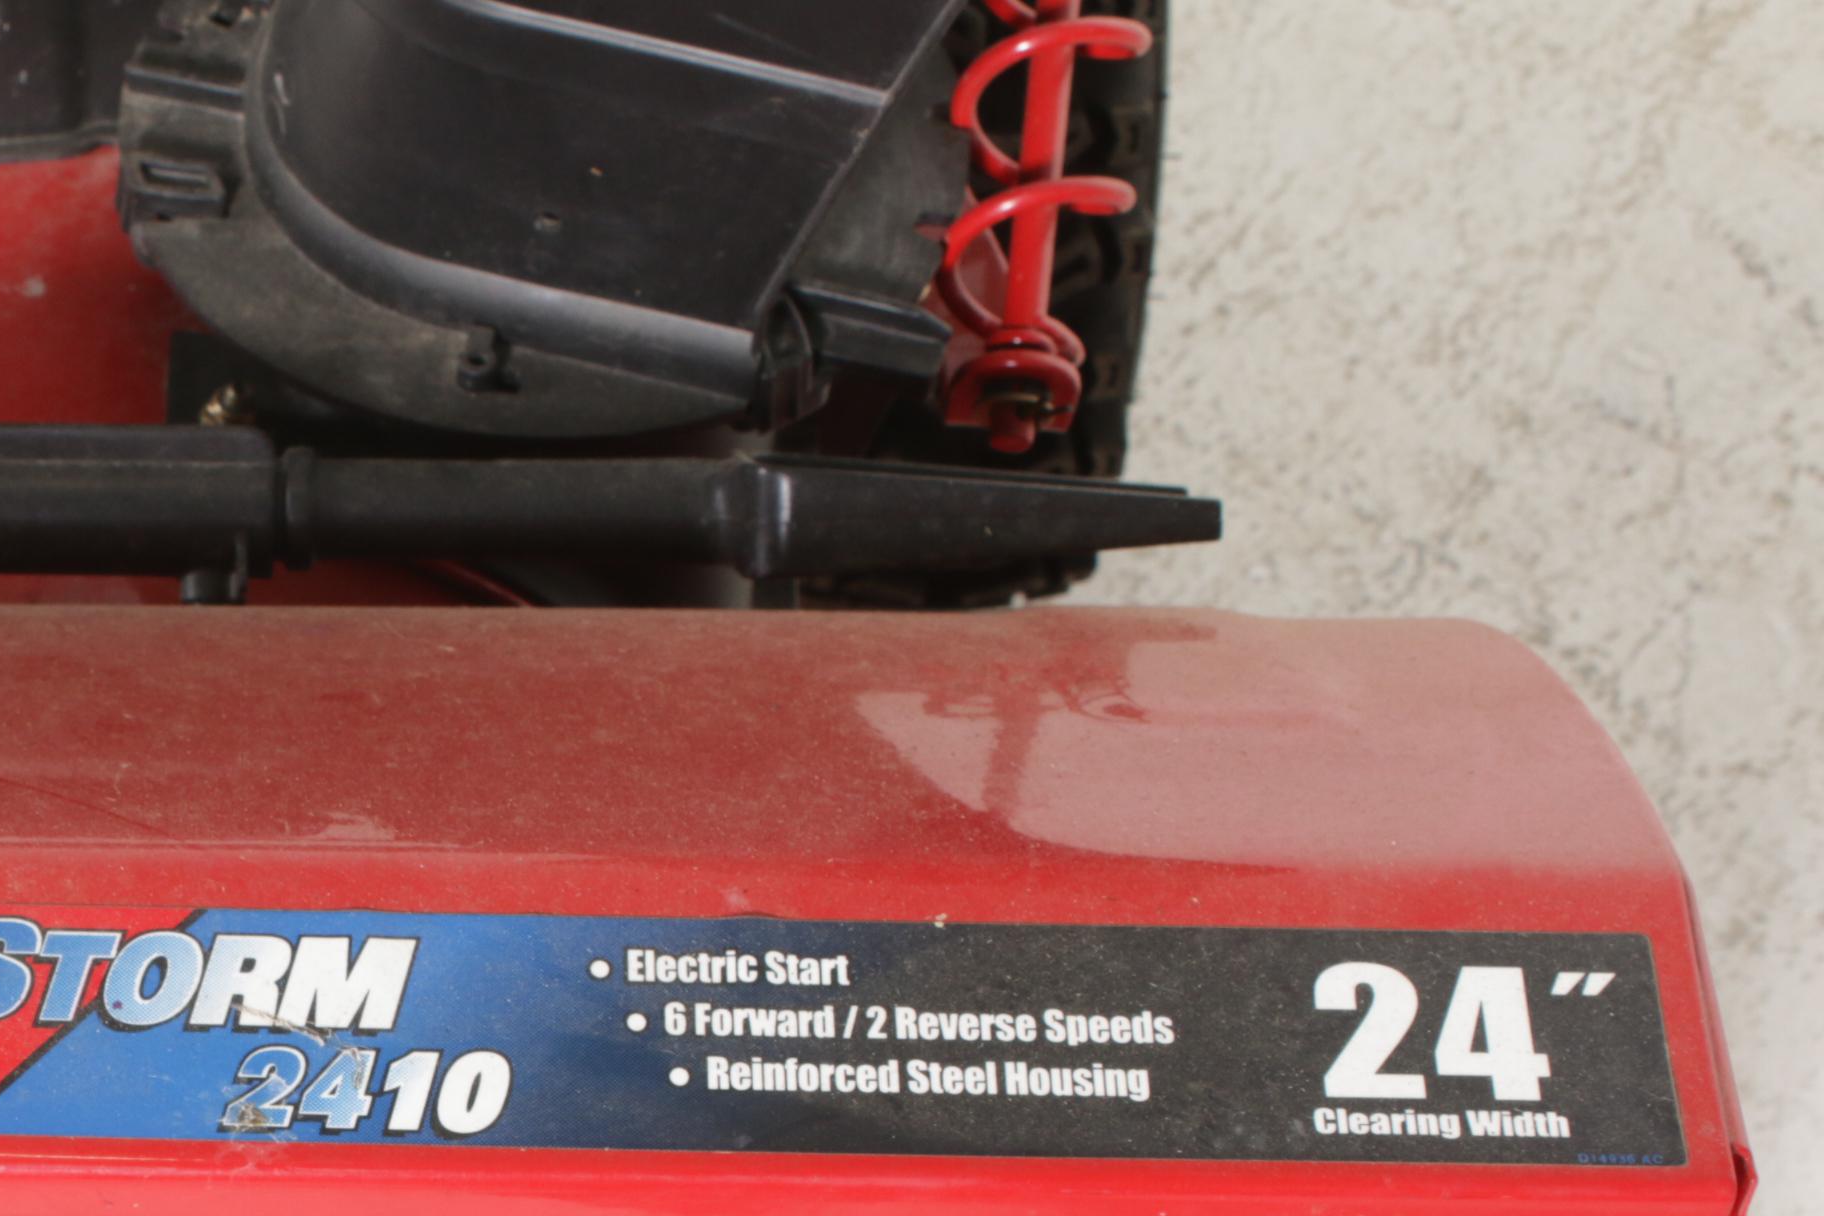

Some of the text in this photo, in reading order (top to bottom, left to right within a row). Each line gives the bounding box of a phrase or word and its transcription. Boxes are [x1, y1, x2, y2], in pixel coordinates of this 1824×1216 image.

[626, 948, 850, 986] Electric Start
[663, 1002, 1175, 1046] 6 Forward / 2 Reverse Speeds
[218, 1044, 514, 1140] 2410
[706, 1056, 1151, 1101] Reinforced Steel Housing
[1313, 1107, 1571, 1139] Clearing Width
